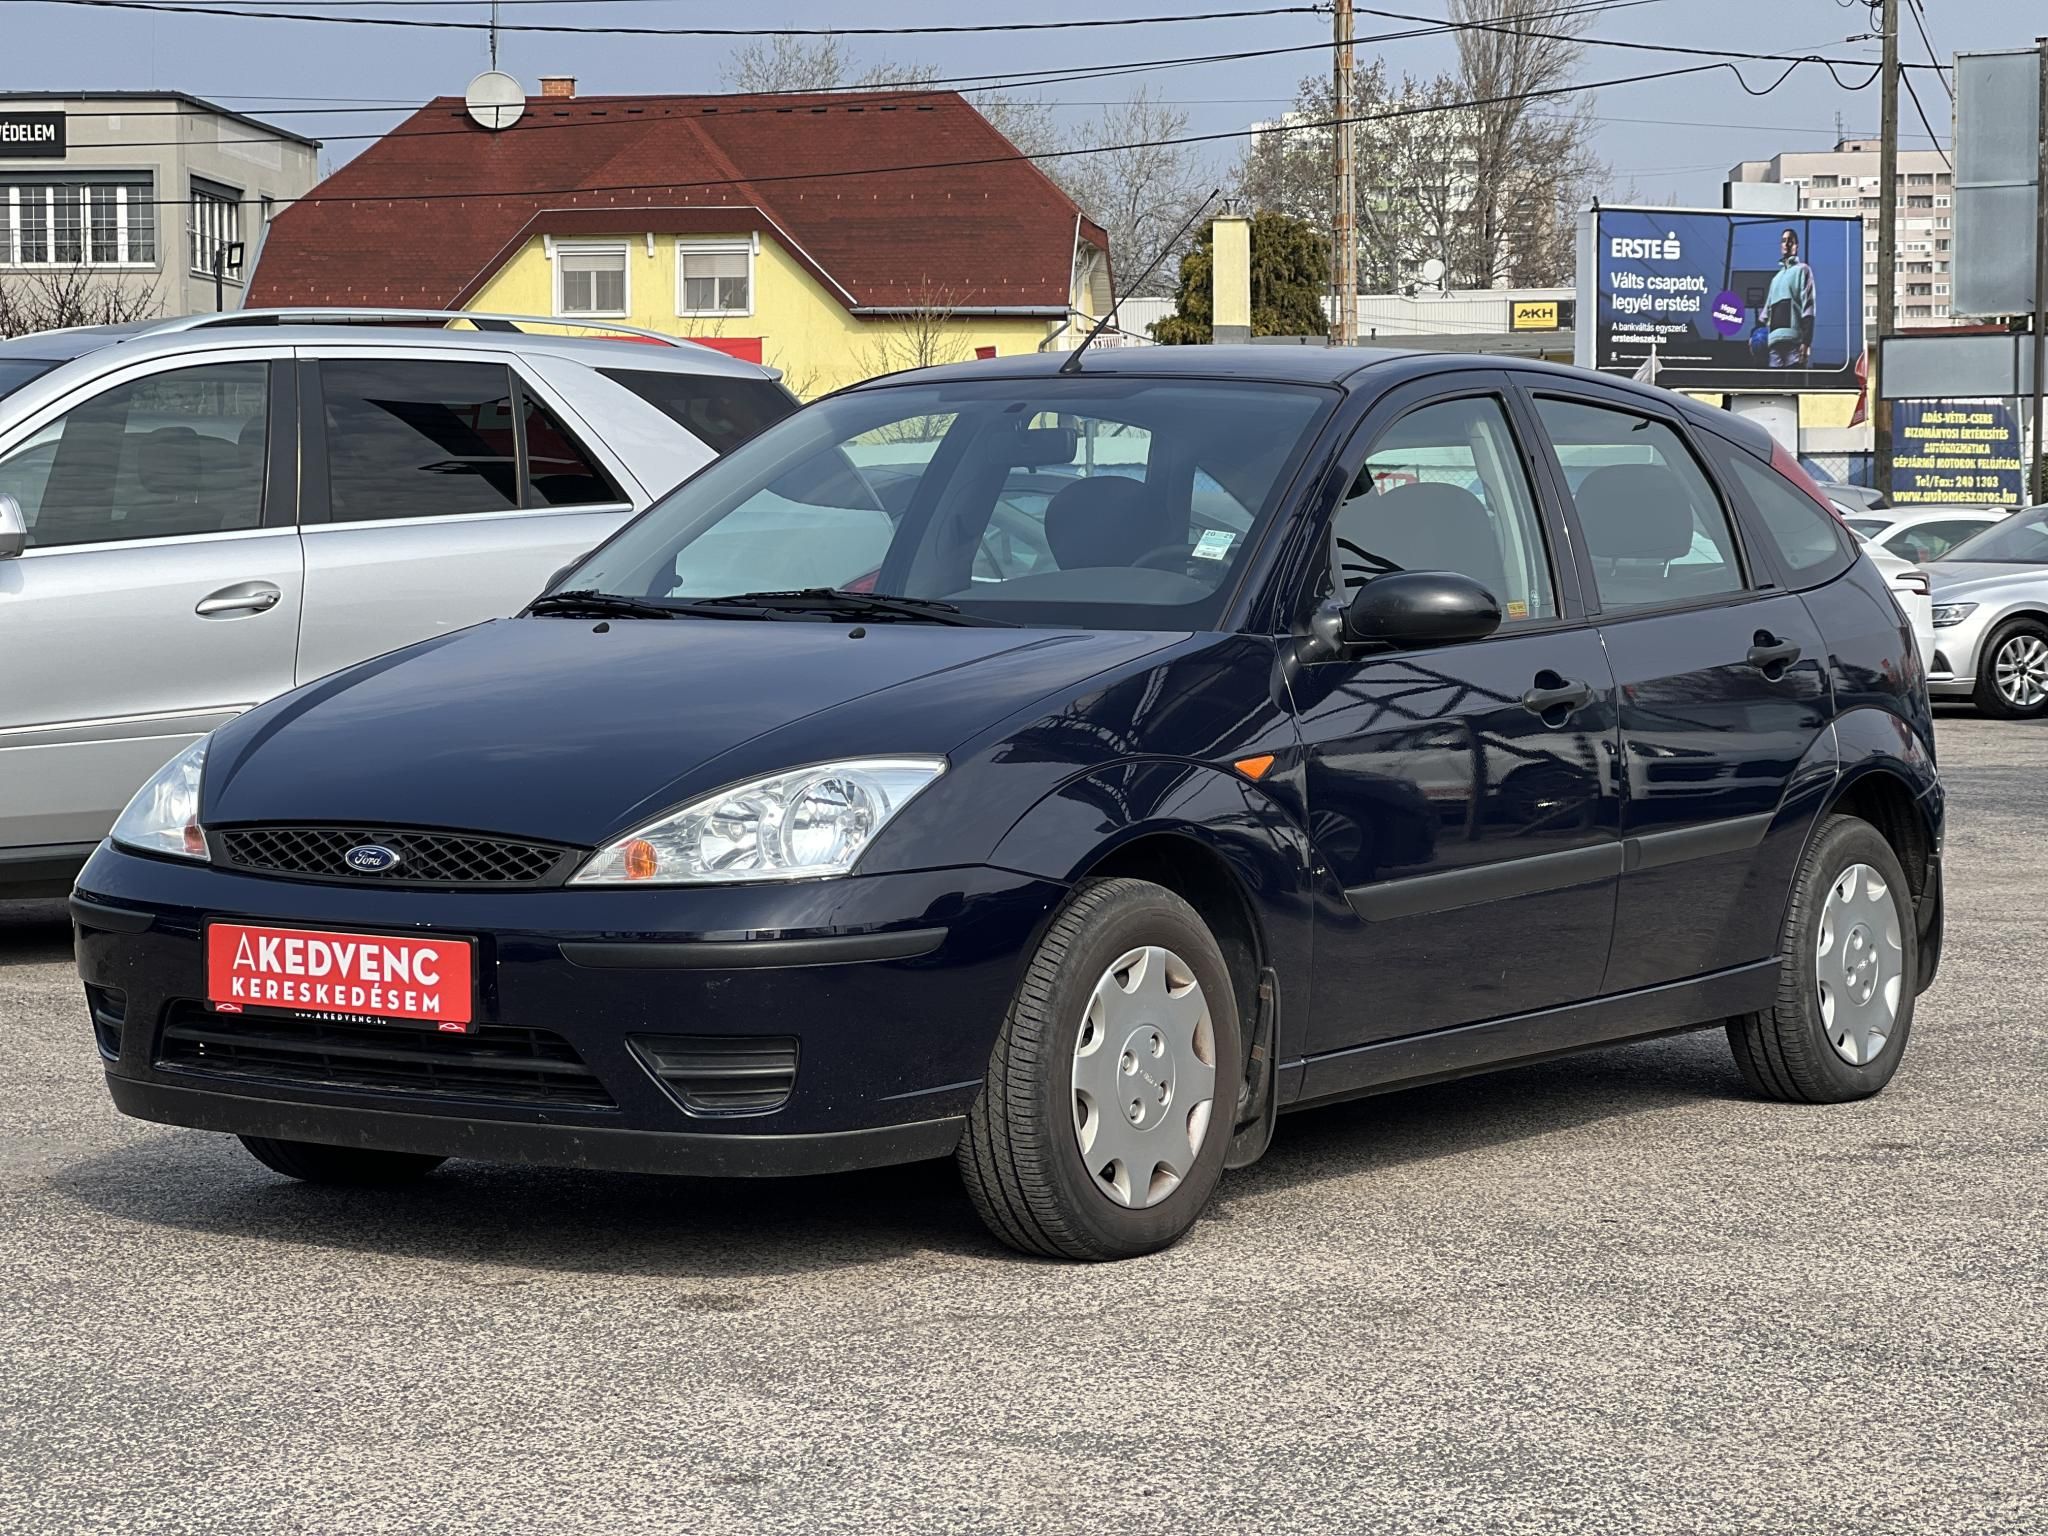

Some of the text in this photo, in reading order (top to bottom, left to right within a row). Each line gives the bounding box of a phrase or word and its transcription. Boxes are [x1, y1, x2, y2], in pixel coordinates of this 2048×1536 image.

[0, 121, 55, 142] ÉDELEM
[1611, 237, 1662, 259] ERSTE
[1611, 271, 1708, 294] Válts csapatot,
[1612, 293, 1700, 314] legyél erstés!
[1611, 321, 1688, 334] A bankváltás egyszerű:
[1611, 334, 1667, 344] erstesleszek.hu
[1921, 411, 1994, 425] ADÁS-VÉTEL-CSERE
[1904, 425, 1960, 439] BIZOMÁNYOSI
[1936, 458, 1977, 469] MOTOROK
[1915, 474, 1955, 488] Tel/Fax:
[1955, 475, 1974, 487] 240
[353, 850, 382, 866] Ford
[231, 975, 441, 1014] KERESKEDÉSEM
